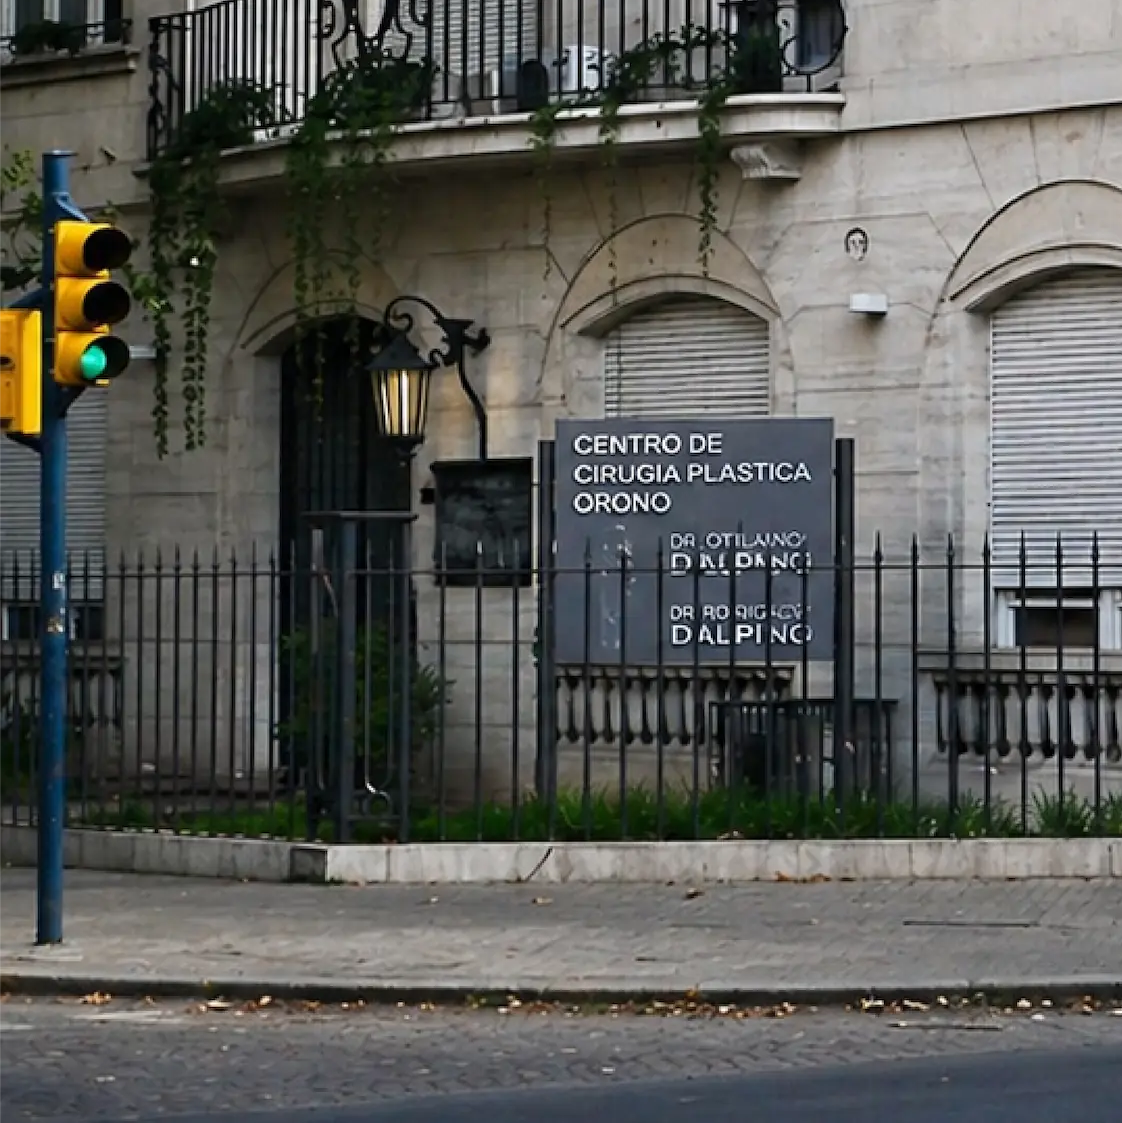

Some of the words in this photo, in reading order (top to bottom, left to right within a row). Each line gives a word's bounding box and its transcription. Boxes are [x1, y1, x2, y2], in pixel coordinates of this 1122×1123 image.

[573, 433, 683, 455] CENTRO
[689, 433, 723, 454] DE
[573, 463, 681, 484] CIRUGIA
[687, 461, 812, 483] PLASTICA
[573, 491, 672, 514] ORONO
